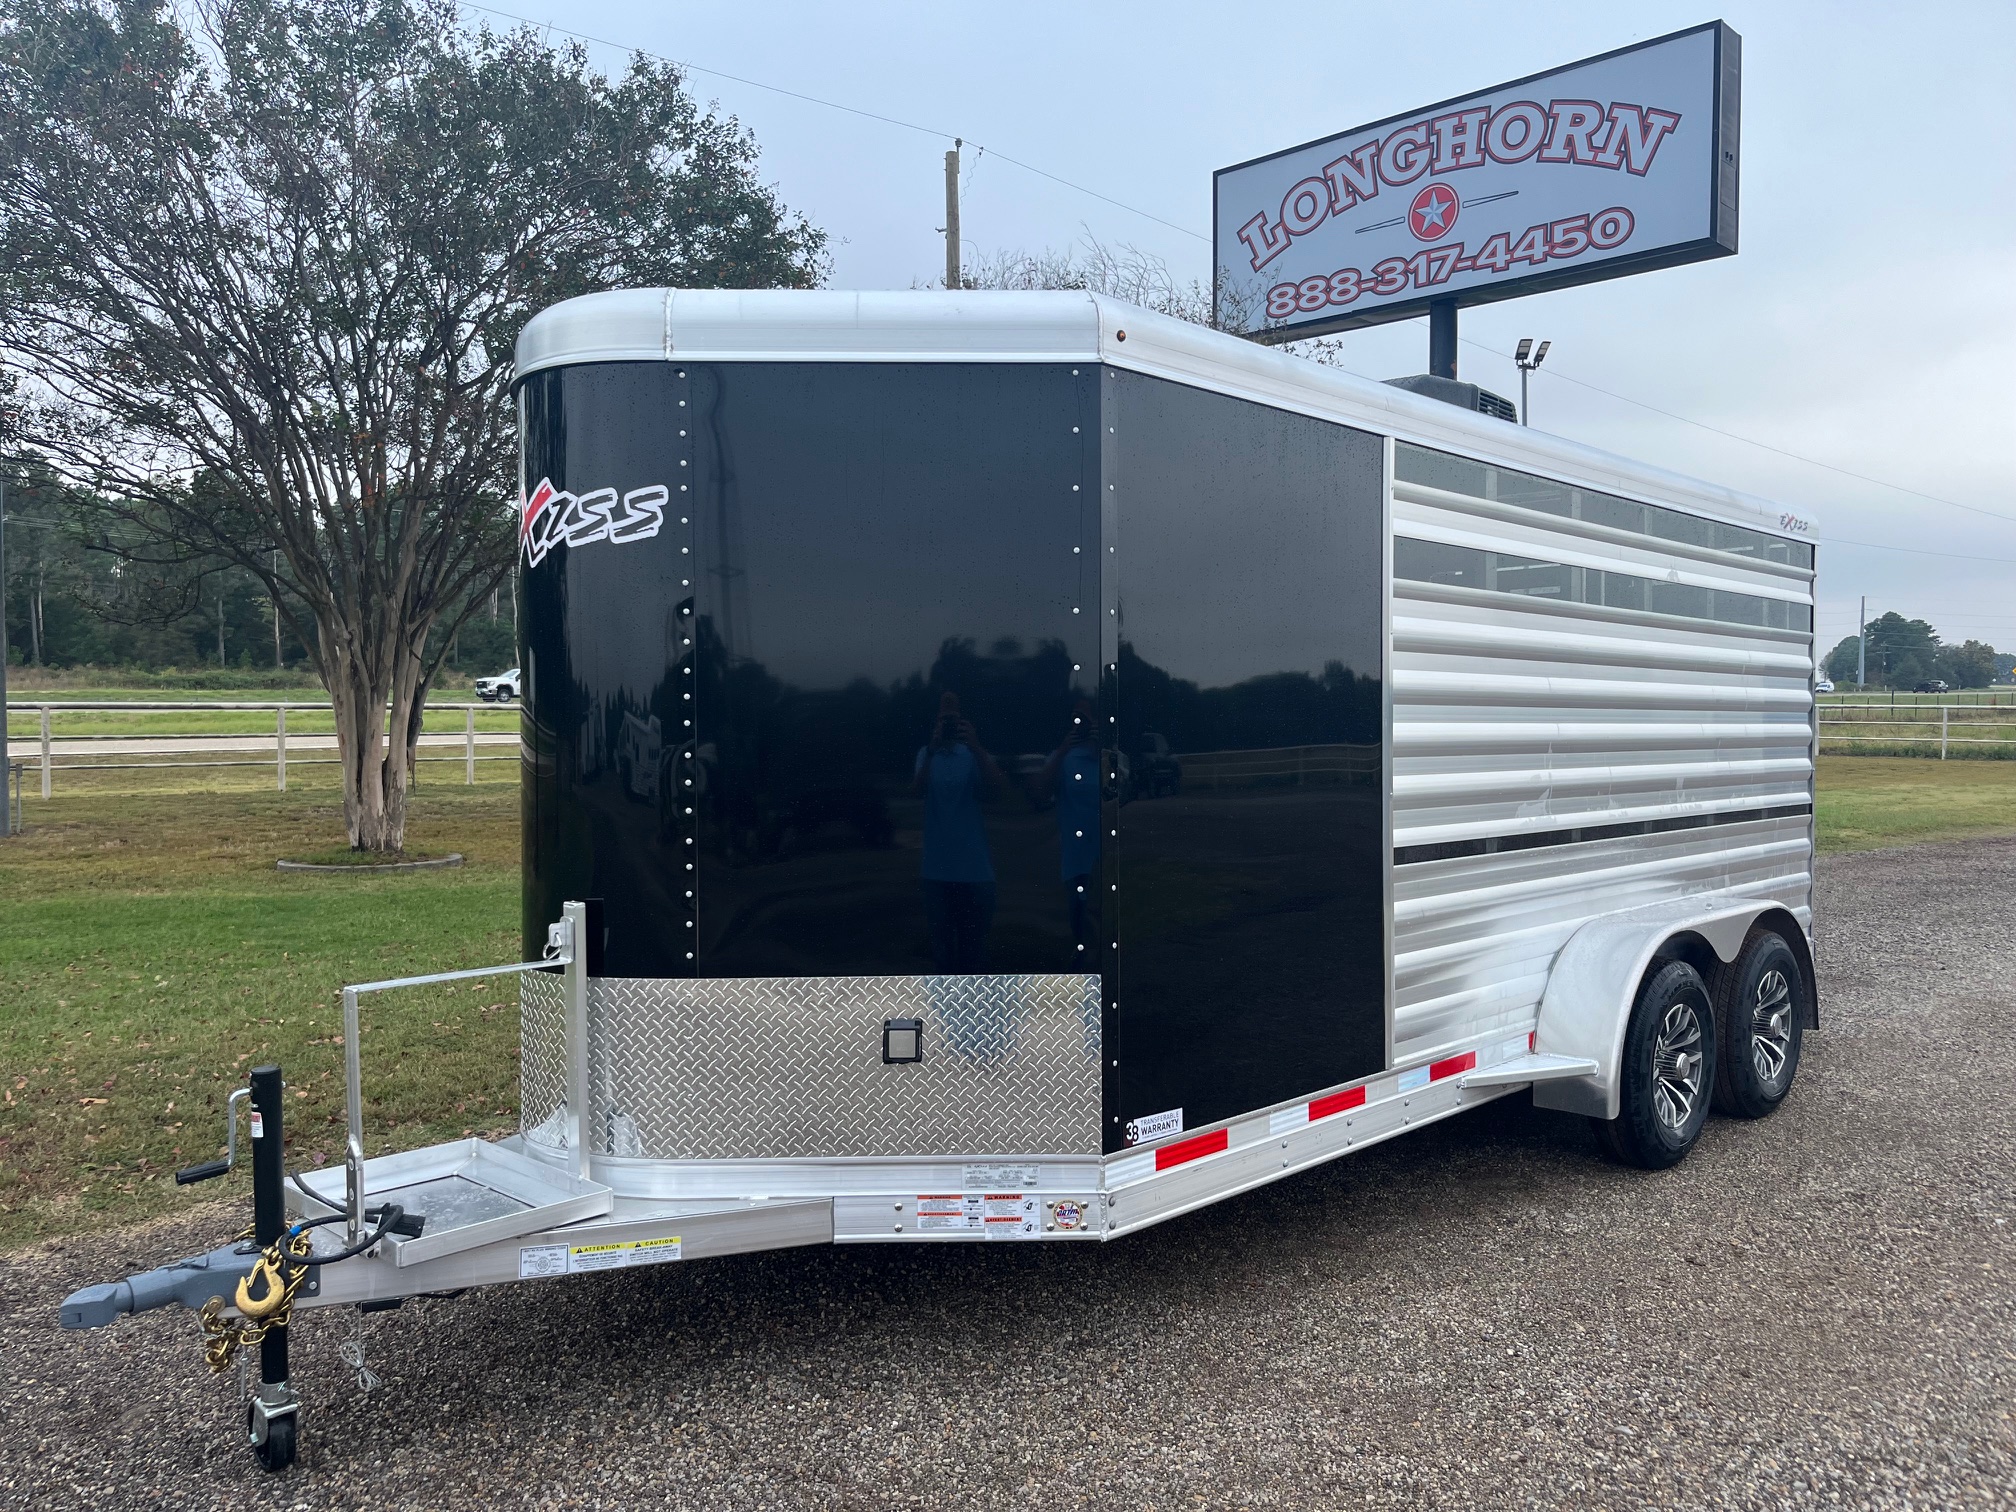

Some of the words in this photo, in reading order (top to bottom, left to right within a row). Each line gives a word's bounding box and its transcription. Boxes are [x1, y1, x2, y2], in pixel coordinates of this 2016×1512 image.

[1238, 99, 1682, 272] LONGHORN
[1266, 207, 1635, 318] 888-317-4450
[519, 477, 669, 568] XISS
[1140, 1111, 1179, 1126] TRANSFERABLE
[1140, 1118, 1179, 1136] WARRANTY
